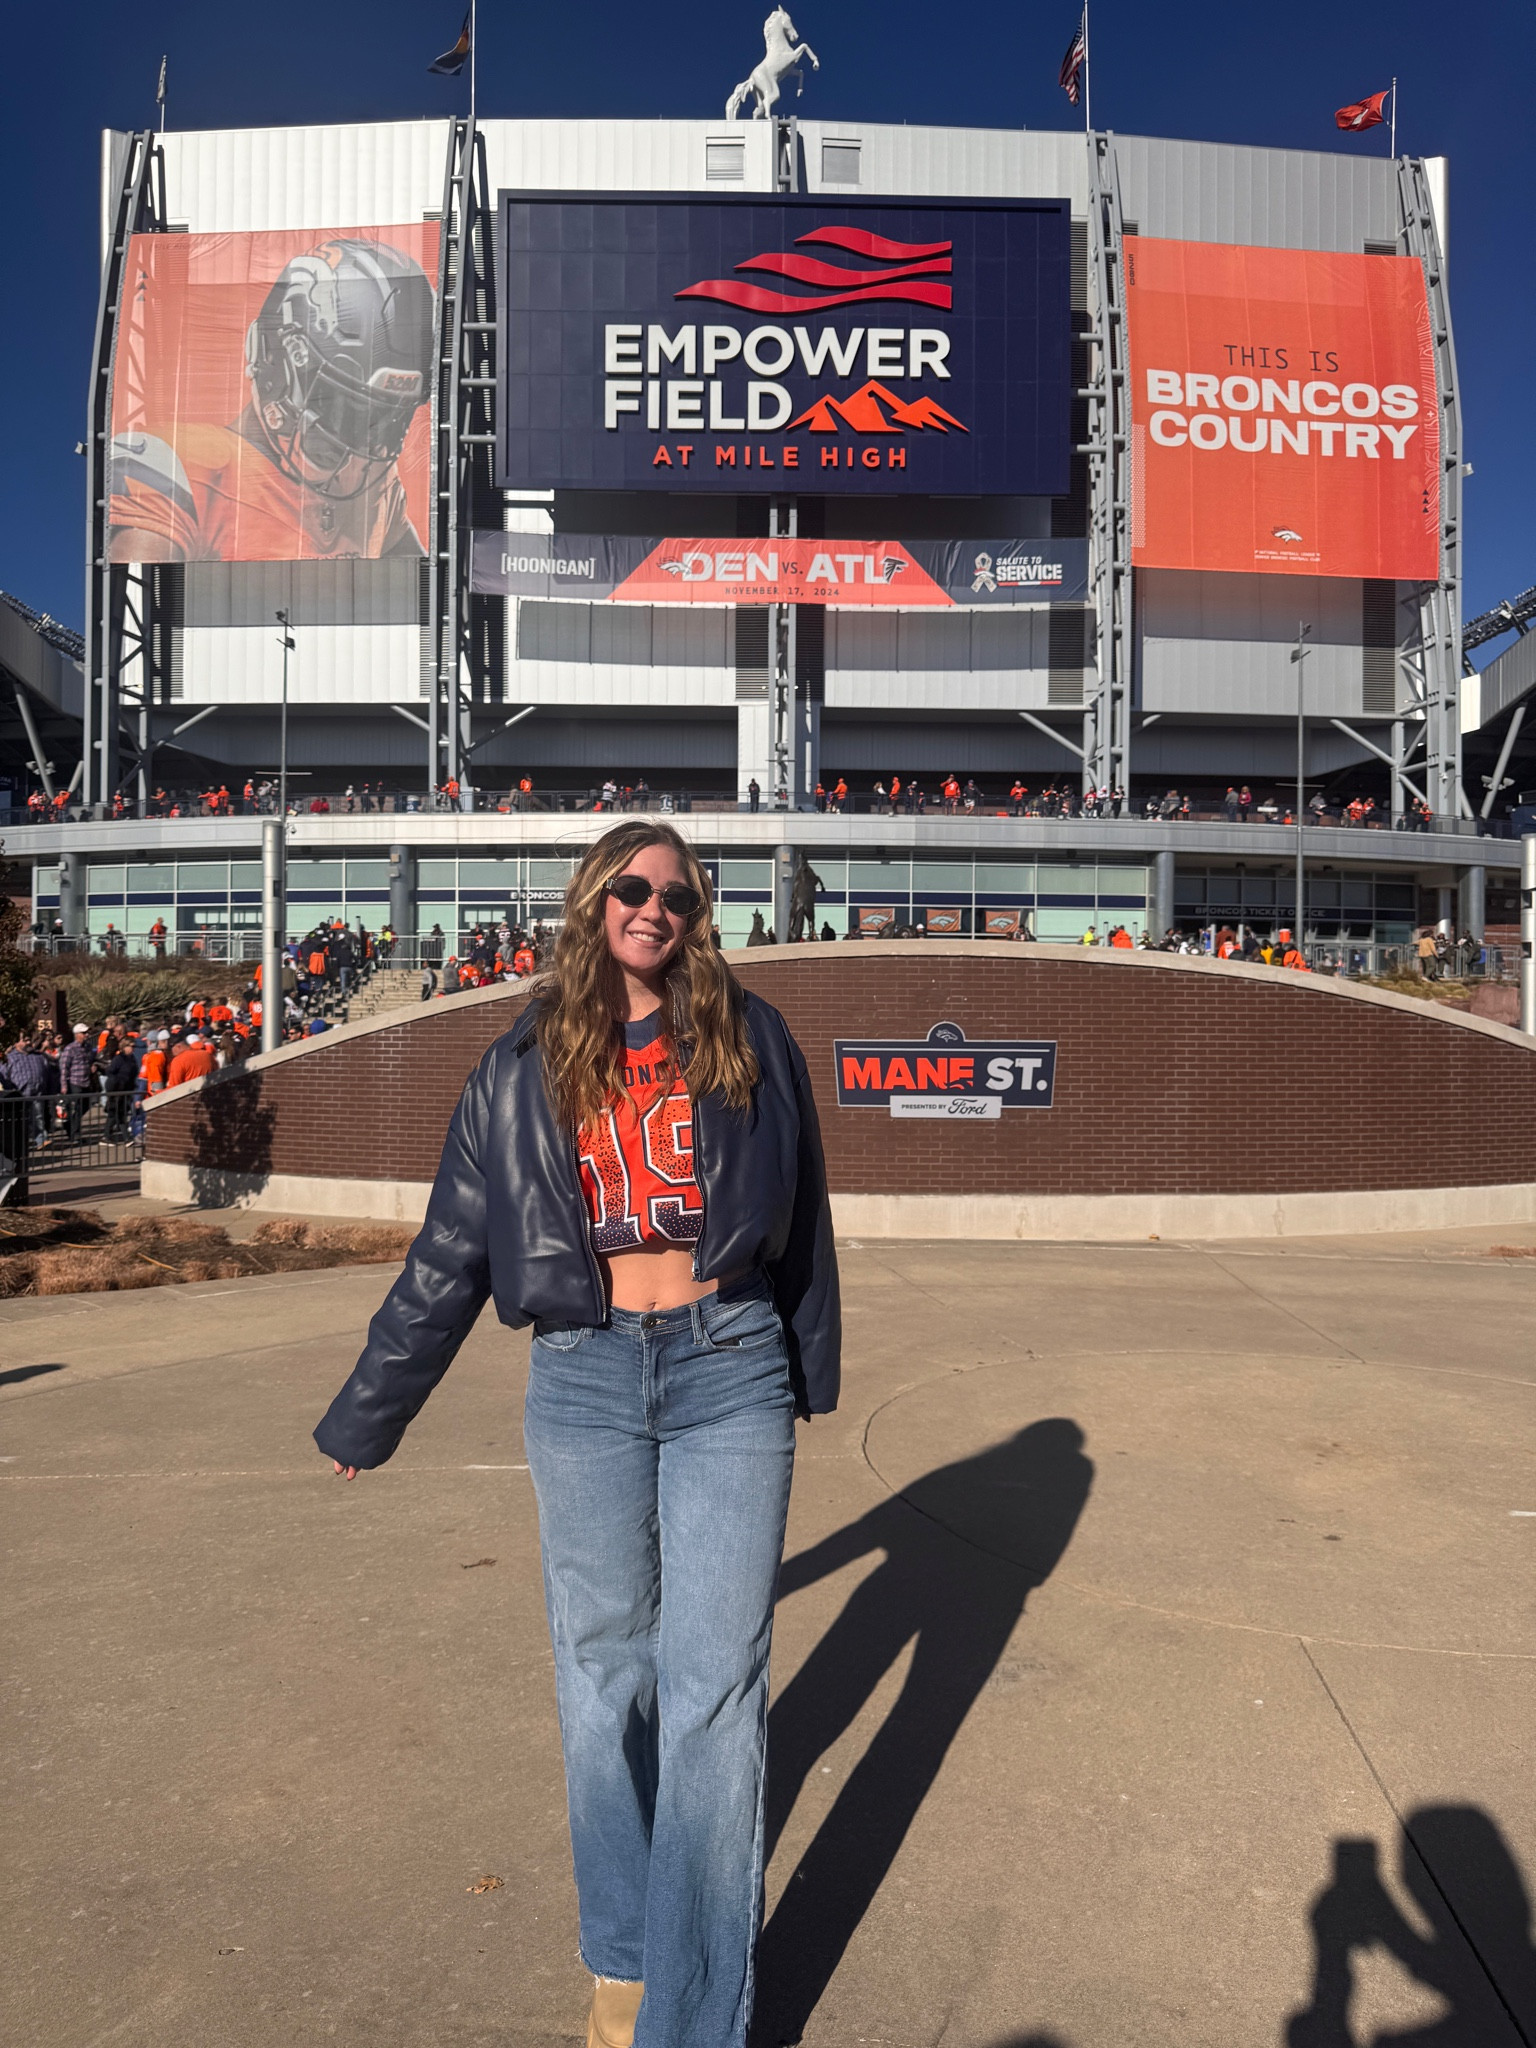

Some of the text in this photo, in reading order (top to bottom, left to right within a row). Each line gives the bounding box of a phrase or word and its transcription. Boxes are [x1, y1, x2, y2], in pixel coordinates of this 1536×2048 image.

[604, 324, 952, 378] EMPOWER
[1223, 345, 1339, 373] THIS IS
[604, 380, 793, 430] FIELD
[1146, 368, 1419, 420] BRONCOS
[1149, 410, 1419, 460] COUNTRY
[653, 446, 906, 468] AT MILE HIGH
[681, 552, 887, 585] DEN VS. ATL
[996, 556, 1042, 566] SALUTE TO
[996, 564, 1063, 582] SERVICE
[725, 586, 779, 596] NOVEMBER
[813, 588, 840, 597] 2024
[510, 891, 564, 900] BRONCOS
[1249, 908, 1287, 917] TICKET
[842, 1056, 1048, 1091] MANE ST.
[947, 1097, 987, 1116] Ford
